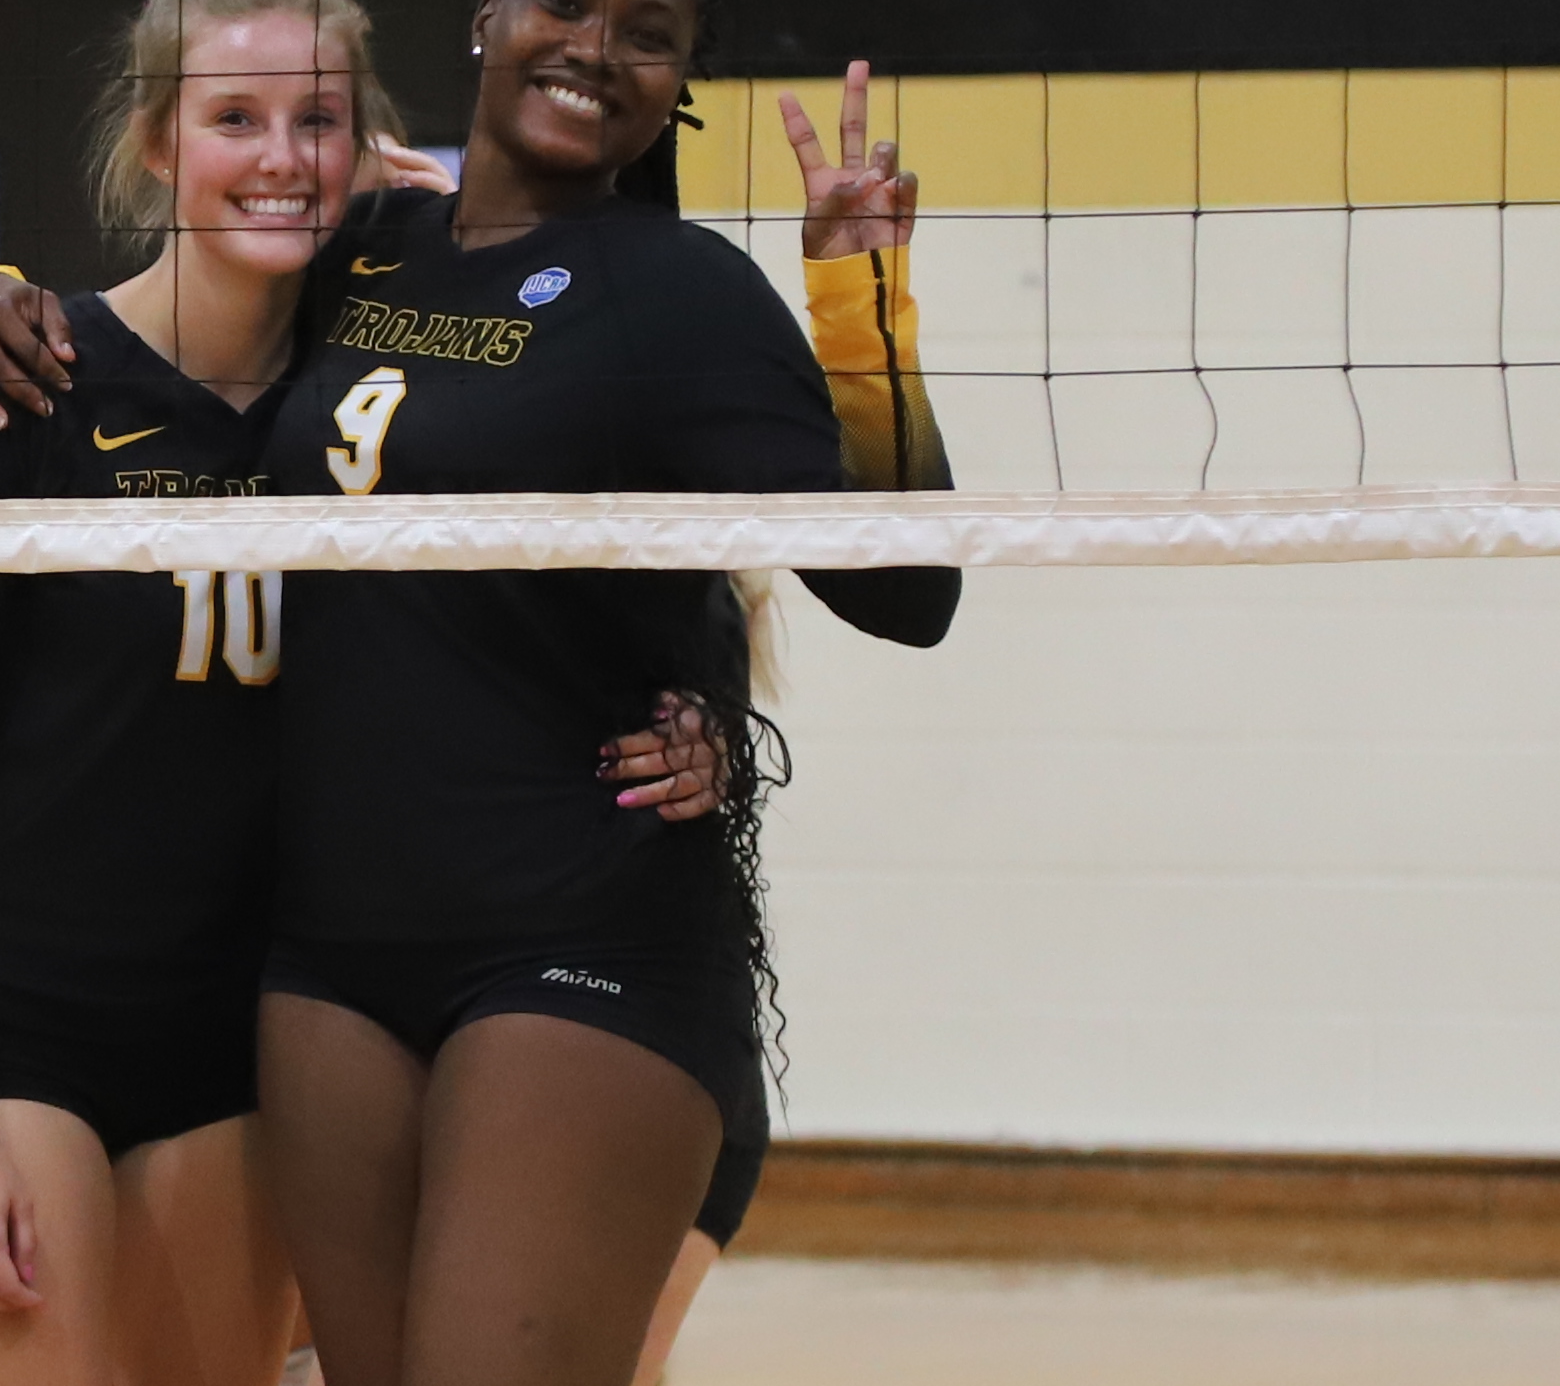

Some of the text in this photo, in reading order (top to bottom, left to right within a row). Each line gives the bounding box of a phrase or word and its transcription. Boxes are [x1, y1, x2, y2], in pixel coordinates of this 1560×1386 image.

[326, 297, 533, 367] TROJANS
[325, 366, 407, 495] 9
[173, 570, 282, 686] 10
